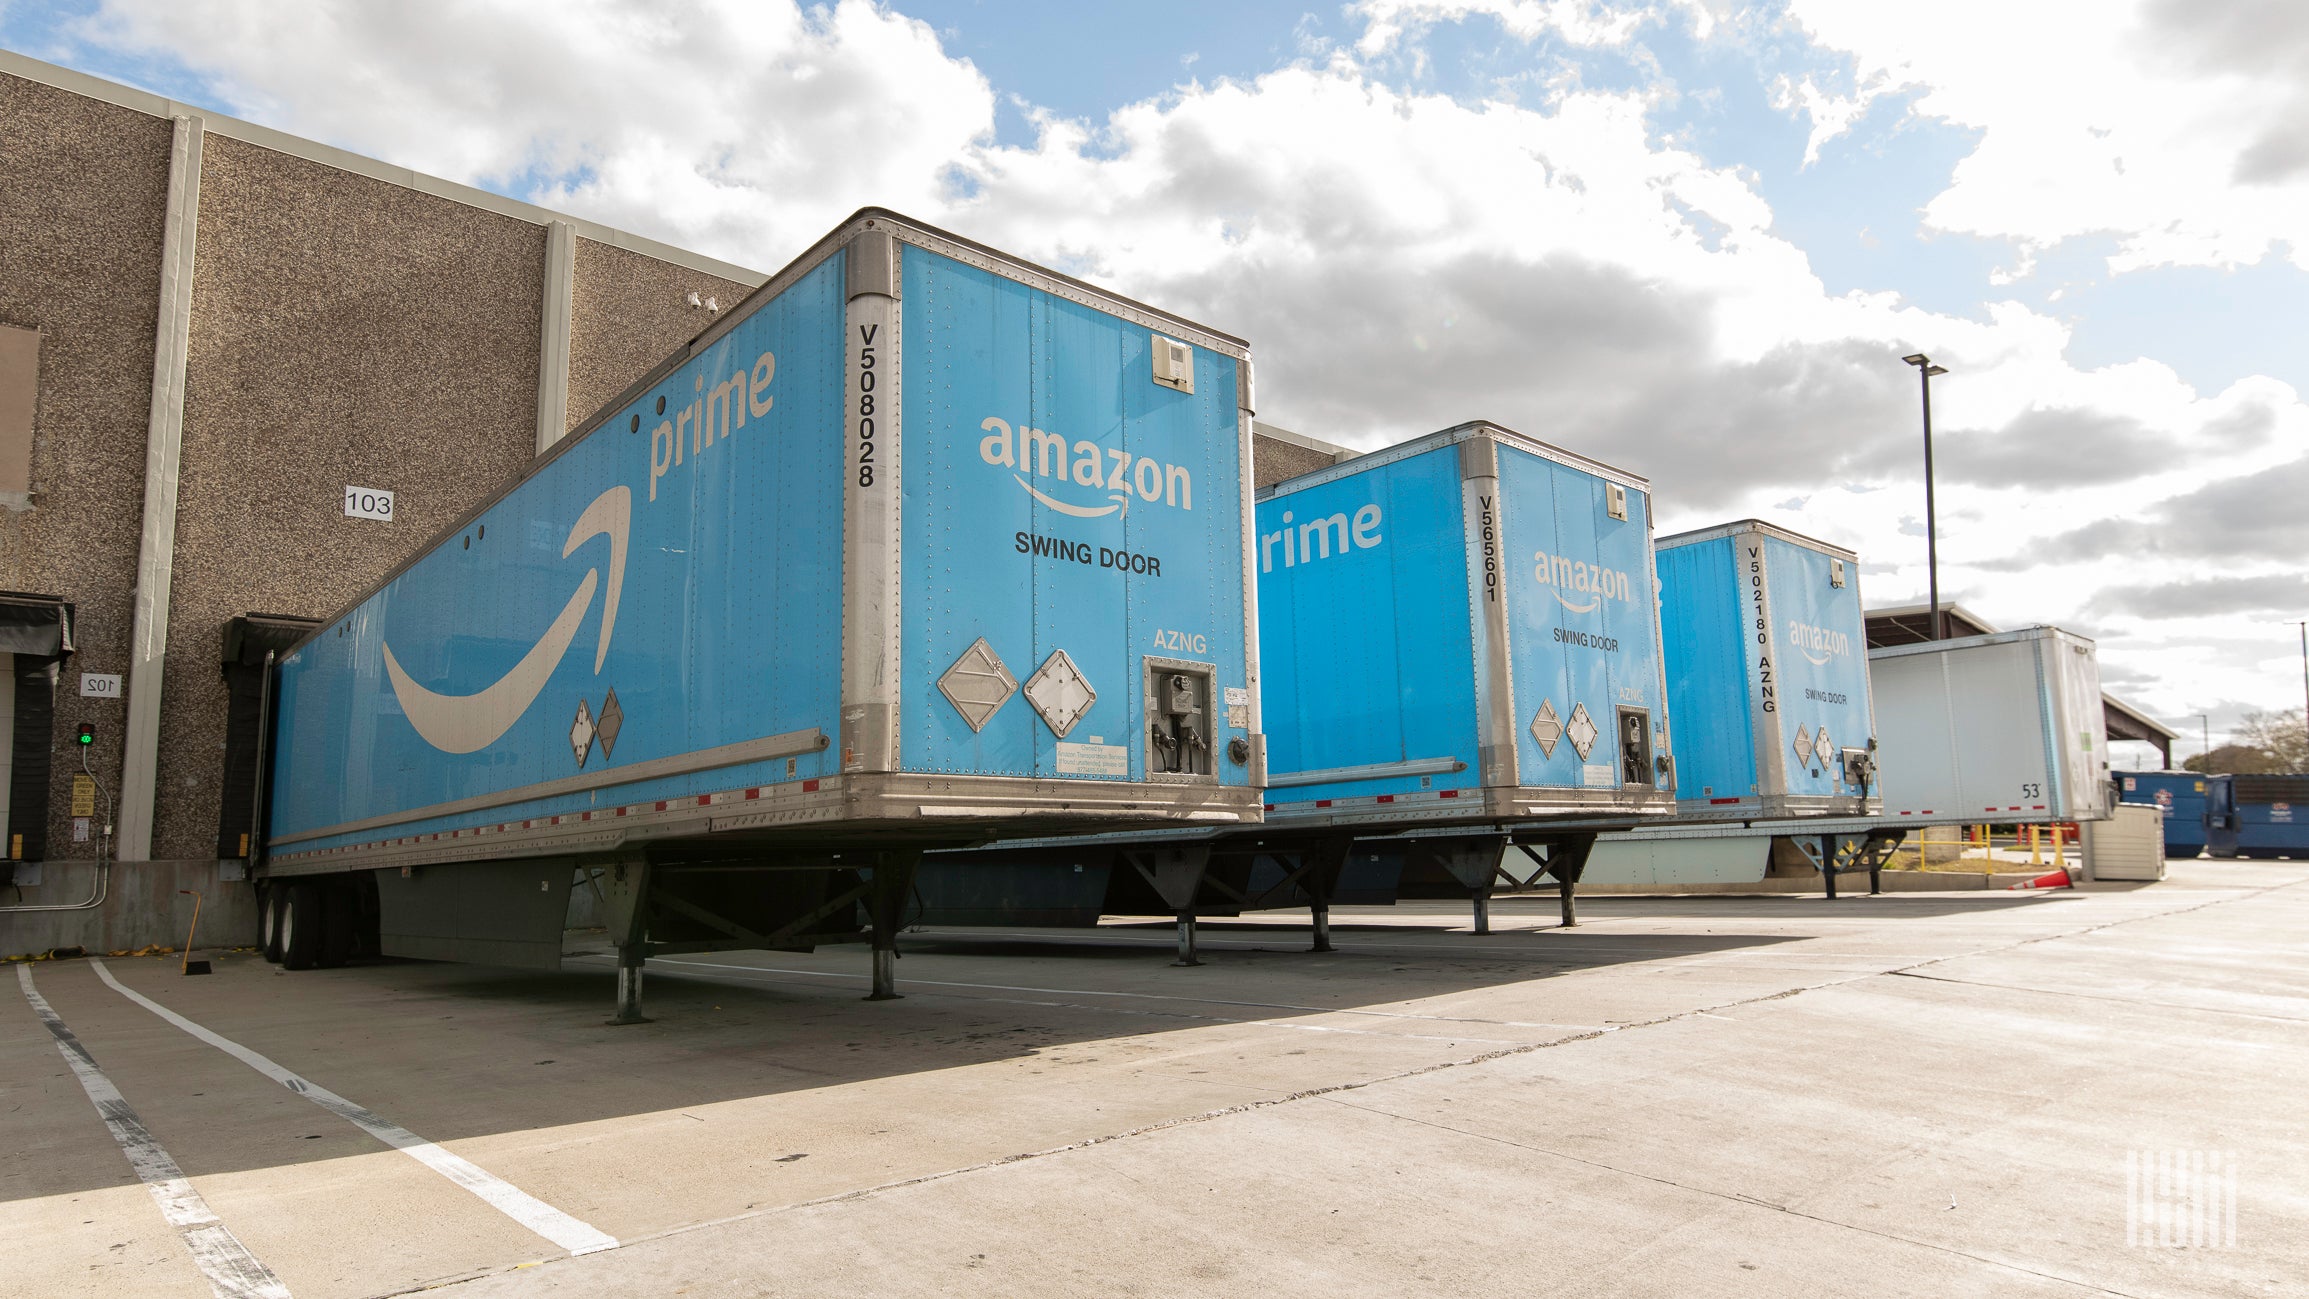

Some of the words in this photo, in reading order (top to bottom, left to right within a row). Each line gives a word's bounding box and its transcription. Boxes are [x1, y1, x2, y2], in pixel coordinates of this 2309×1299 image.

[650, 352, 775, 502] prime
[858, 324, 877, 487] V508028
[979, 416, 1192, 511] amazon
[347, 492, 391, 515] 103
[1015, 531, 1092, 565] SWING
[1100, 547, 1161, 577] DOOR
[1256, 504, 1382, 574] rime
[1479, 496, 1496, 601] V565601
[1534, 551, 1630, 602] amazon
[1153, 628, 1207, 654] AZNG
[1553, 628, 1588, 647] SWING
[1590, 635, 1619, 653] DOOR
[1748, 547, 1766, 645] V502180
[1759, 657, 1775, 713] AZNG
[1789, 620, 1849, 657] amazon
[1619, 687, 1644, 703] AZNG
[1805, 688, 1828, 702] SWING
[1828, 691, 1848, 705] DOOR
